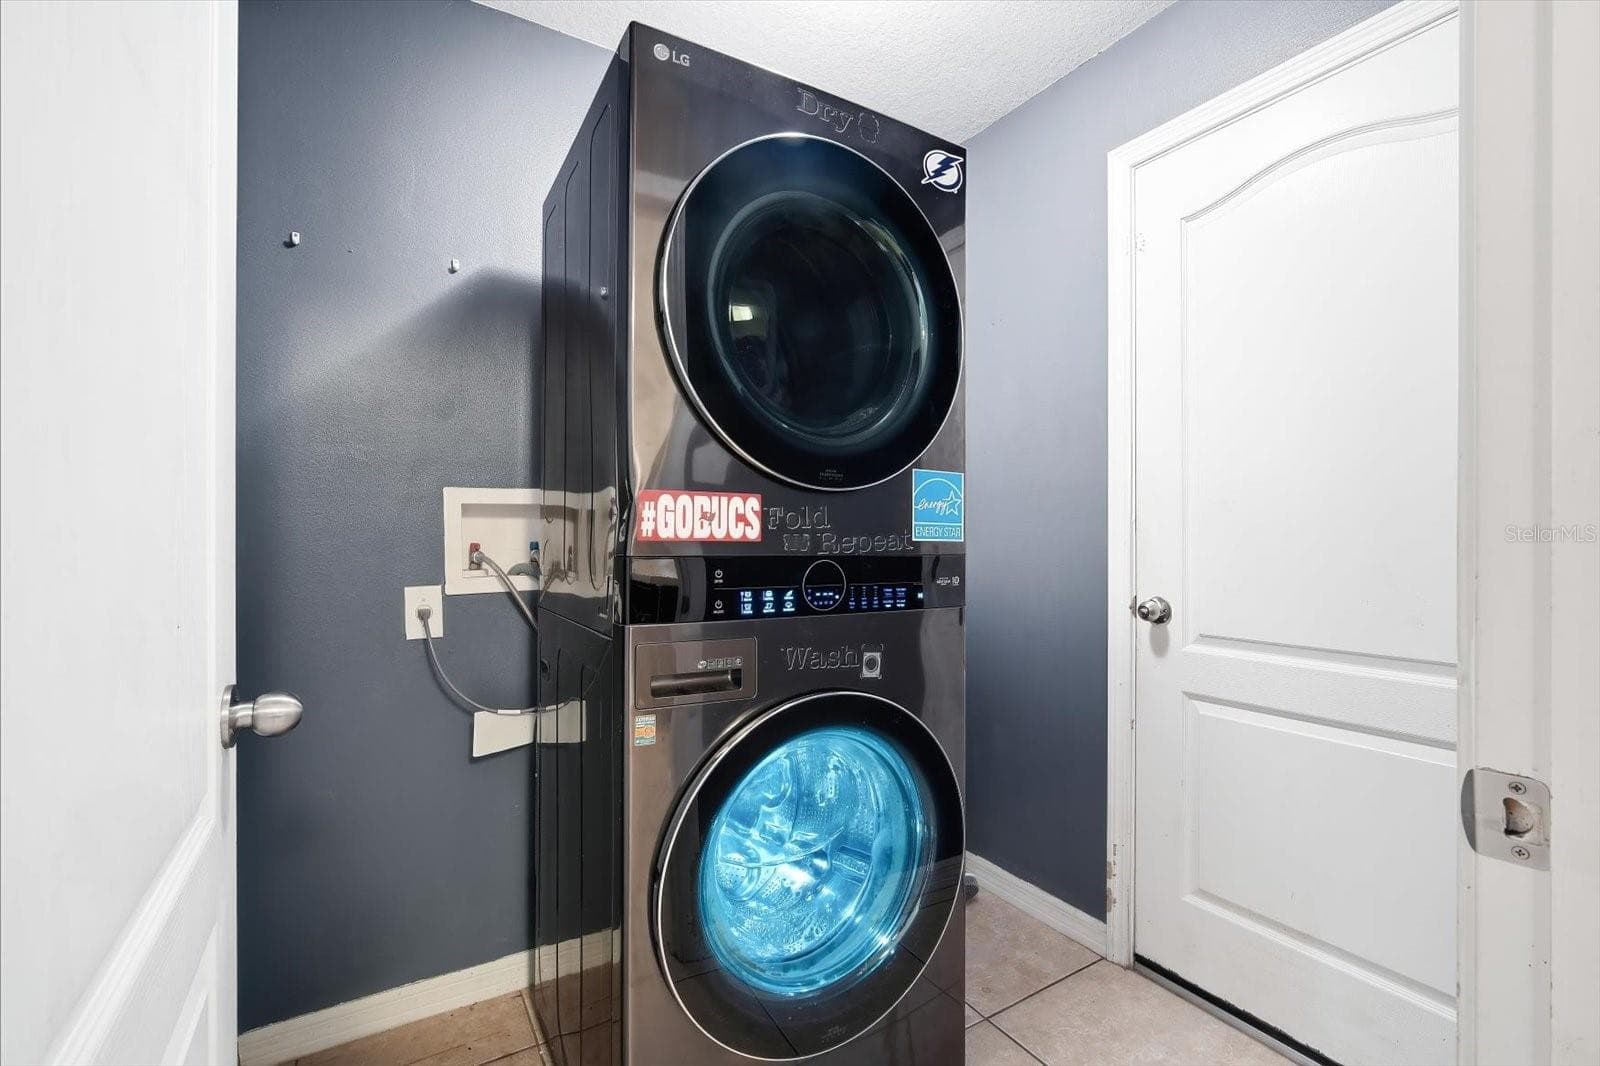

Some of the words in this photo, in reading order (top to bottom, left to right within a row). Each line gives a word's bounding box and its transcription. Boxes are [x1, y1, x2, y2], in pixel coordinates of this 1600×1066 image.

[672, 50, 690, 67] LG
[796, 87, 854, 133] Dry
[640, 493, 761, 540] #GOBUCS
[763, 505, 831, 530] Fold
[816, 529, 914, 556] Repeat
[915, 526, 943, 537] ENERGY
[943, 527, 961, 537] STAR
[780, 645, 860, 671] Wash
